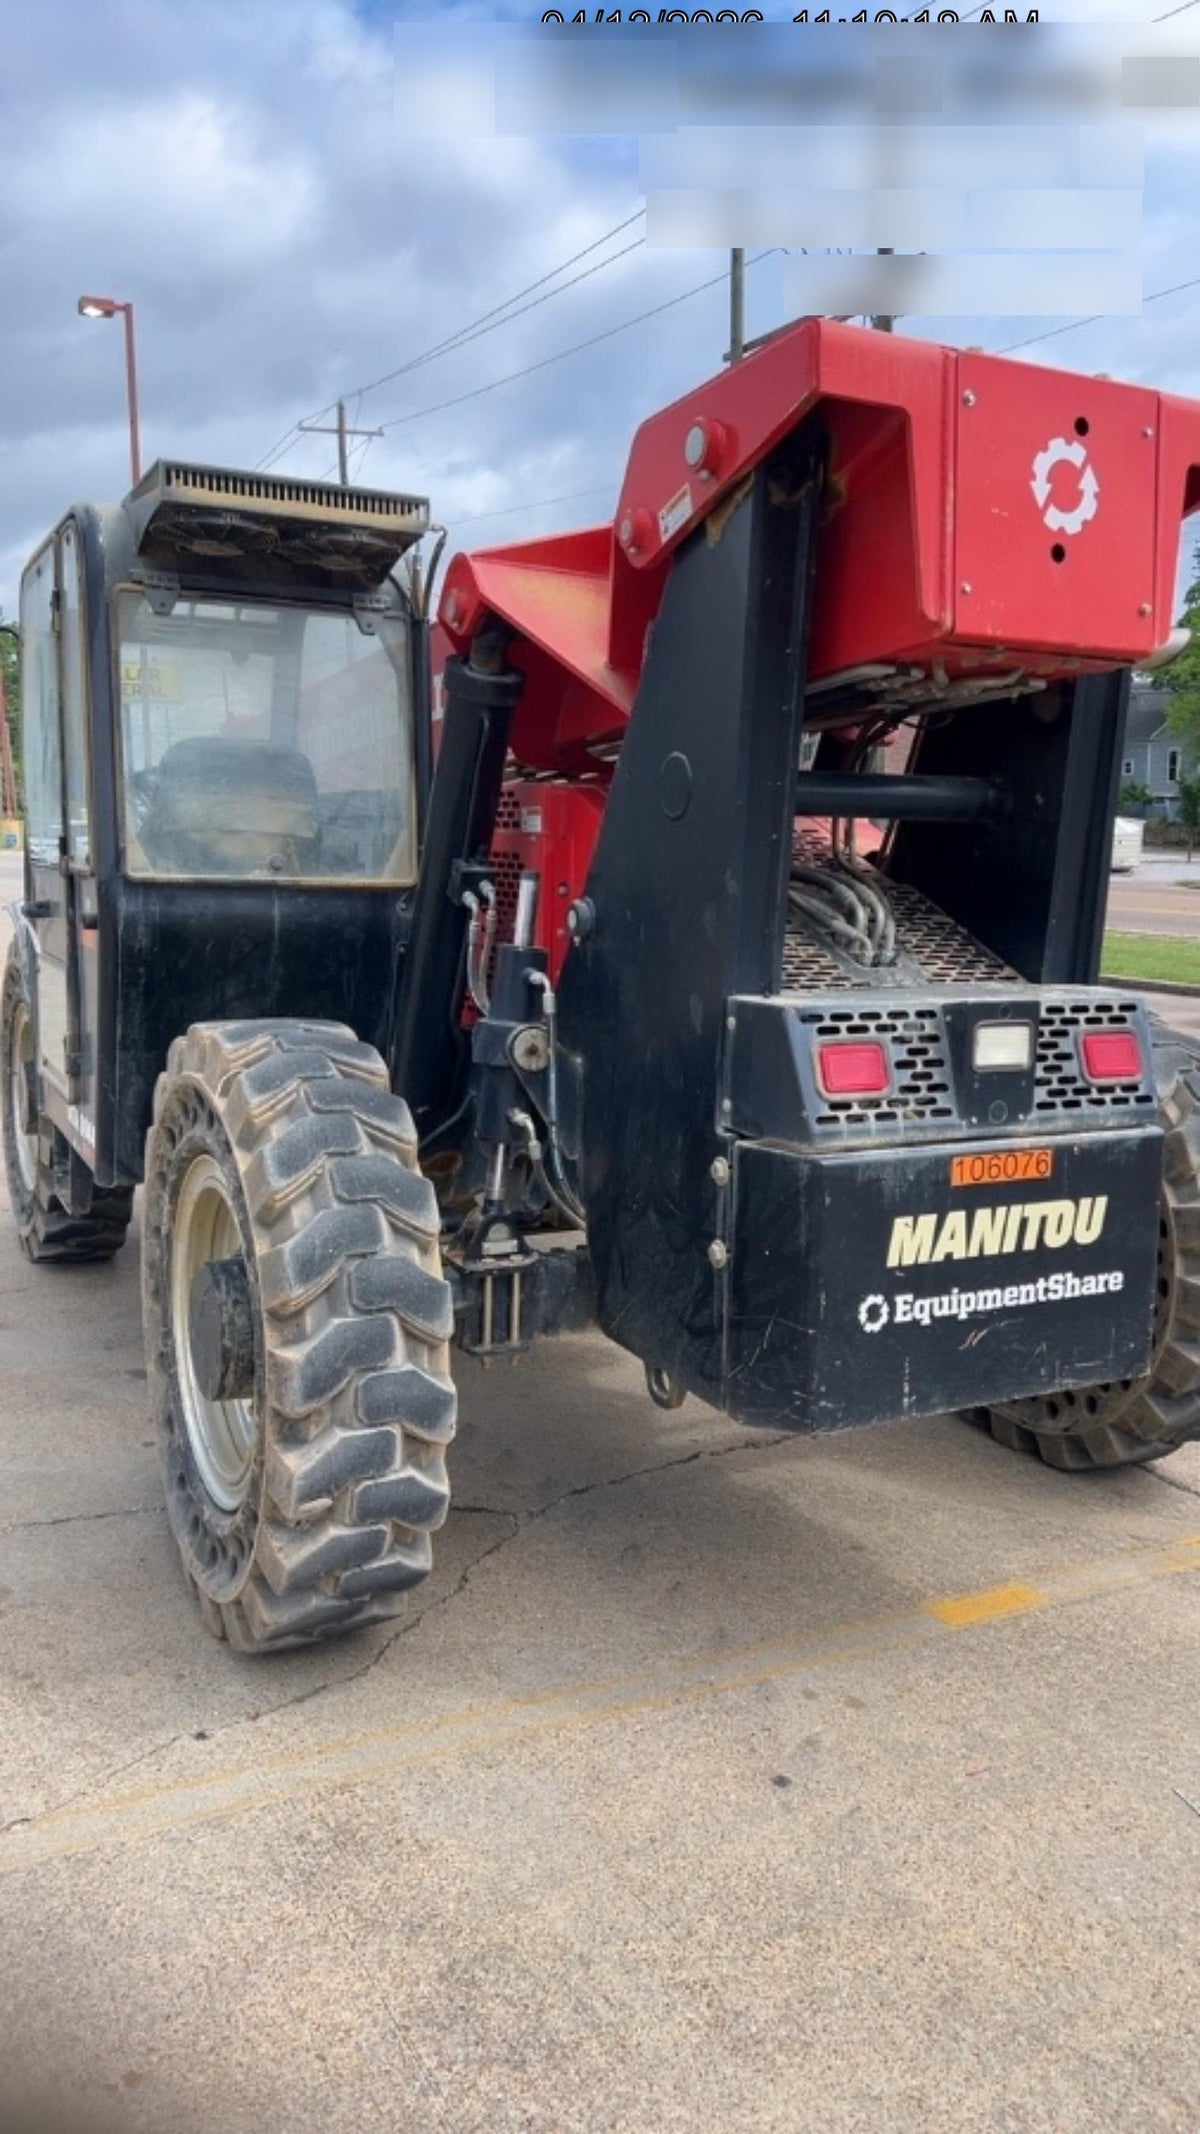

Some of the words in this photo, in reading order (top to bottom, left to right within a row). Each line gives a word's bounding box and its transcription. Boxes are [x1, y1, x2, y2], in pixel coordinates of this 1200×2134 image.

[954, 1152, 1050, 1182] 106076
[886, 1195, 1108, 1268] MANITOU
[894, 1271, 1124, 1326] EquipmentShare
